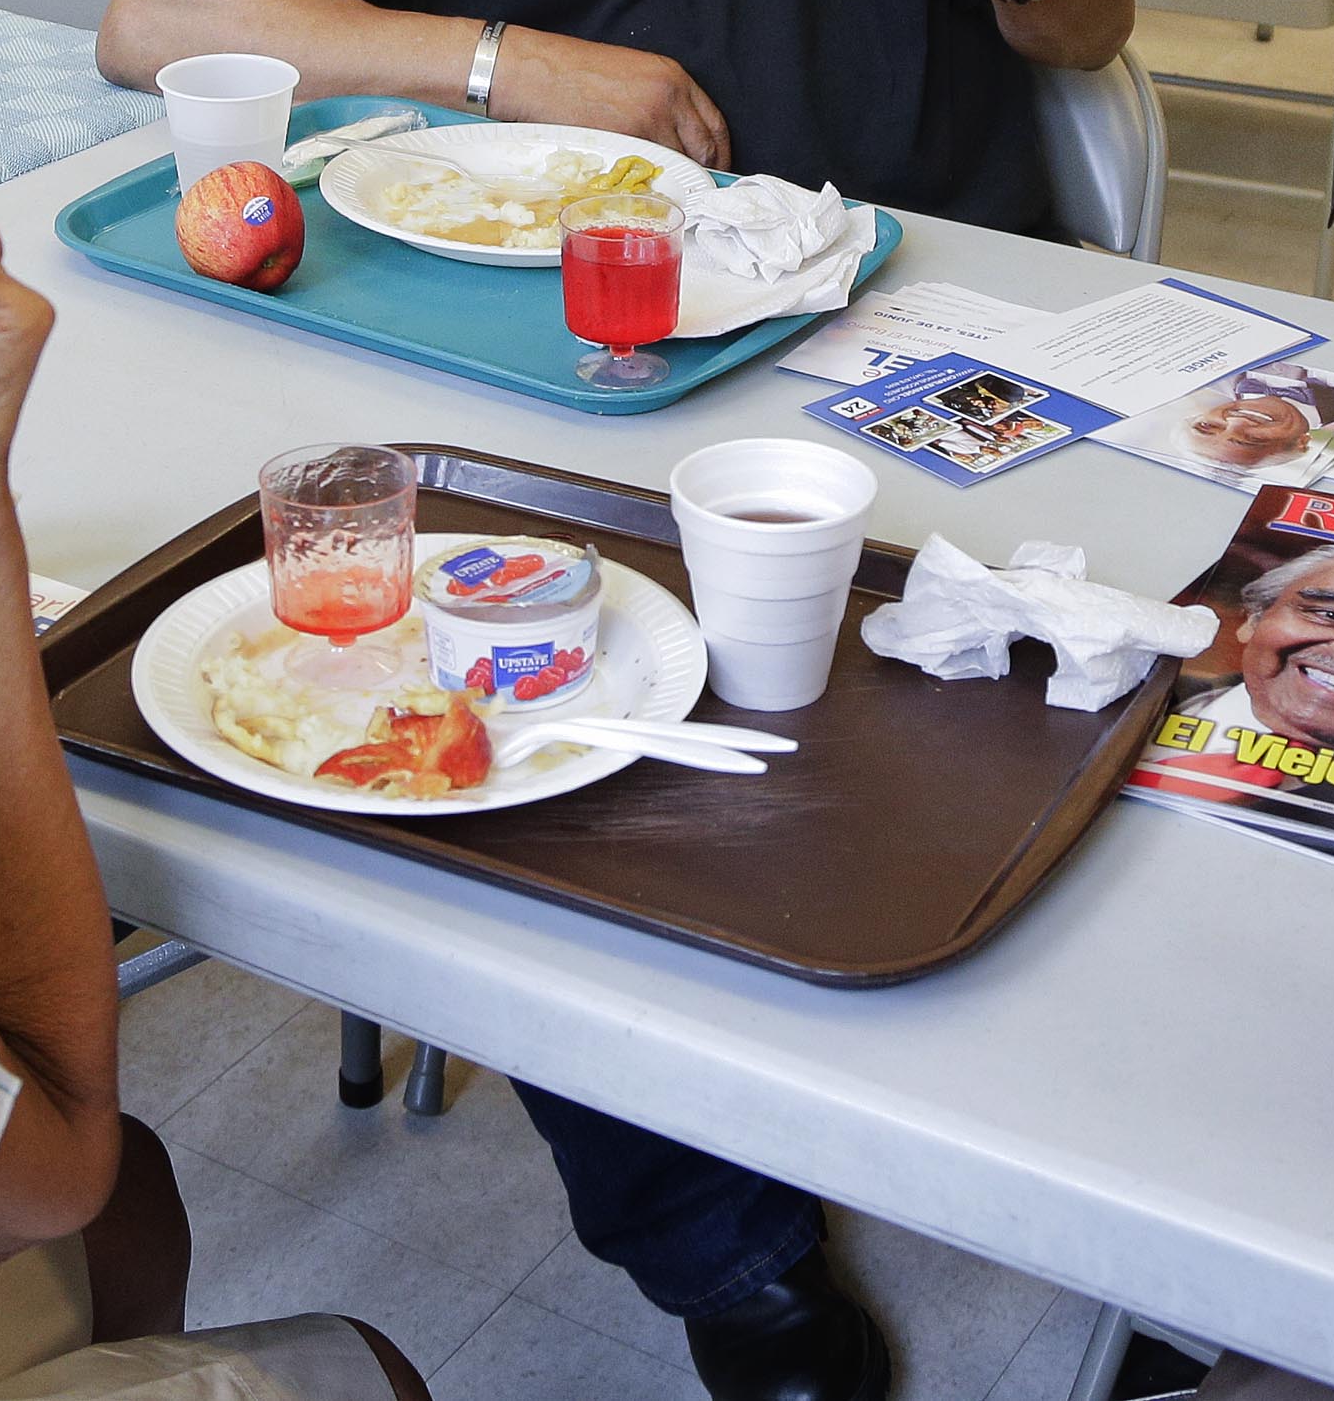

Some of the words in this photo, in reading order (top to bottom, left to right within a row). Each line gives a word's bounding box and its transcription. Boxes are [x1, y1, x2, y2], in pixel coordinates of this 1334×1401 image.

[874, 310, 915, 324] JUNIO
[917, 319, 935, 330] DE
[1178, 350, 1228, 373] RANGEL
[840, 400, 868, 415] 24
[454, 555, 501, 578] UPSTATE
[498, 653, 550, 669] UPSTATE
[1155, 713, 1216, 753] El
